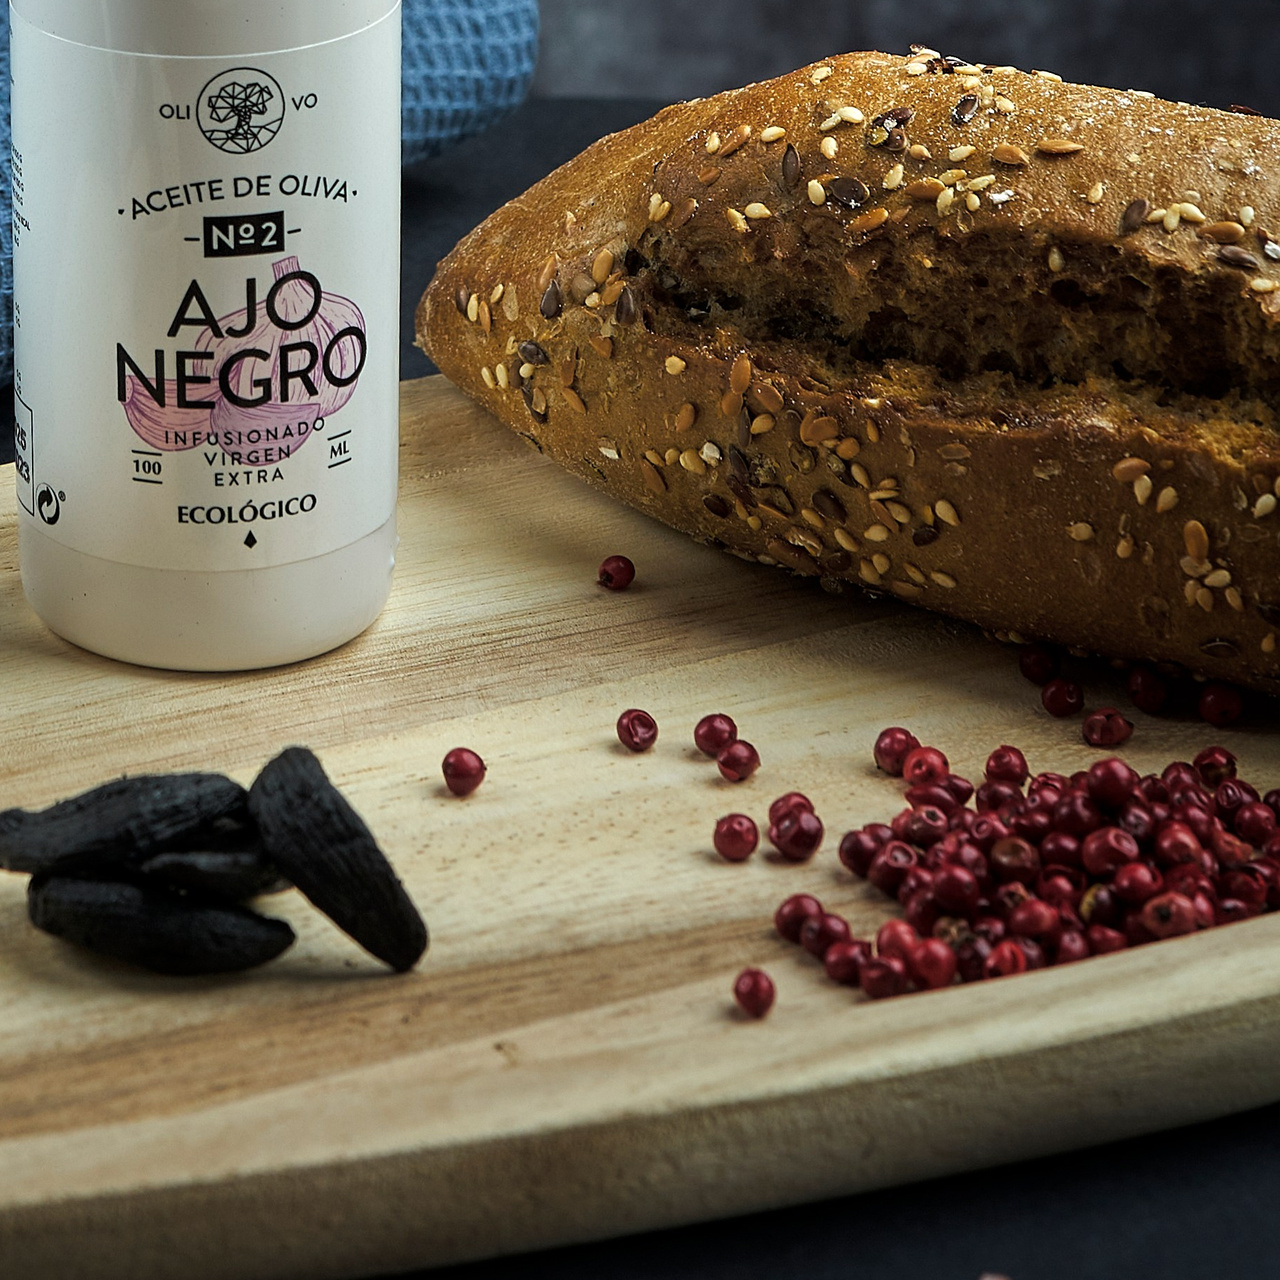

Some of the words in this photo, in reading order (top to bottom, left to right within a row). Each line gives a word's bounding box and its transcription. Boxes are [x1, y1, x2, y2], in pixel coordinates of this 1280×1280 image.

[159, 103, 190, 120] OLI
[291, 92, 318, 111] VO
[131, 179, 225, 220] ACEITE
[233, 175, 272, 198] DE
[278, 174, 349, 203] OLIVA
[167, 270, 322, 338] AJO
[117, 326, 367, 409] NEGRO
[164, 417, 325, 446] INFUSIONADO
[132, 459, 162, 475] 100
[329, 440, 350, 460] ML
[203, 444, 291, 467] VIRGEN
[214, 467, 285, 487] EXTRA
[177, 493, 317, 524] ECOLÓGICO
